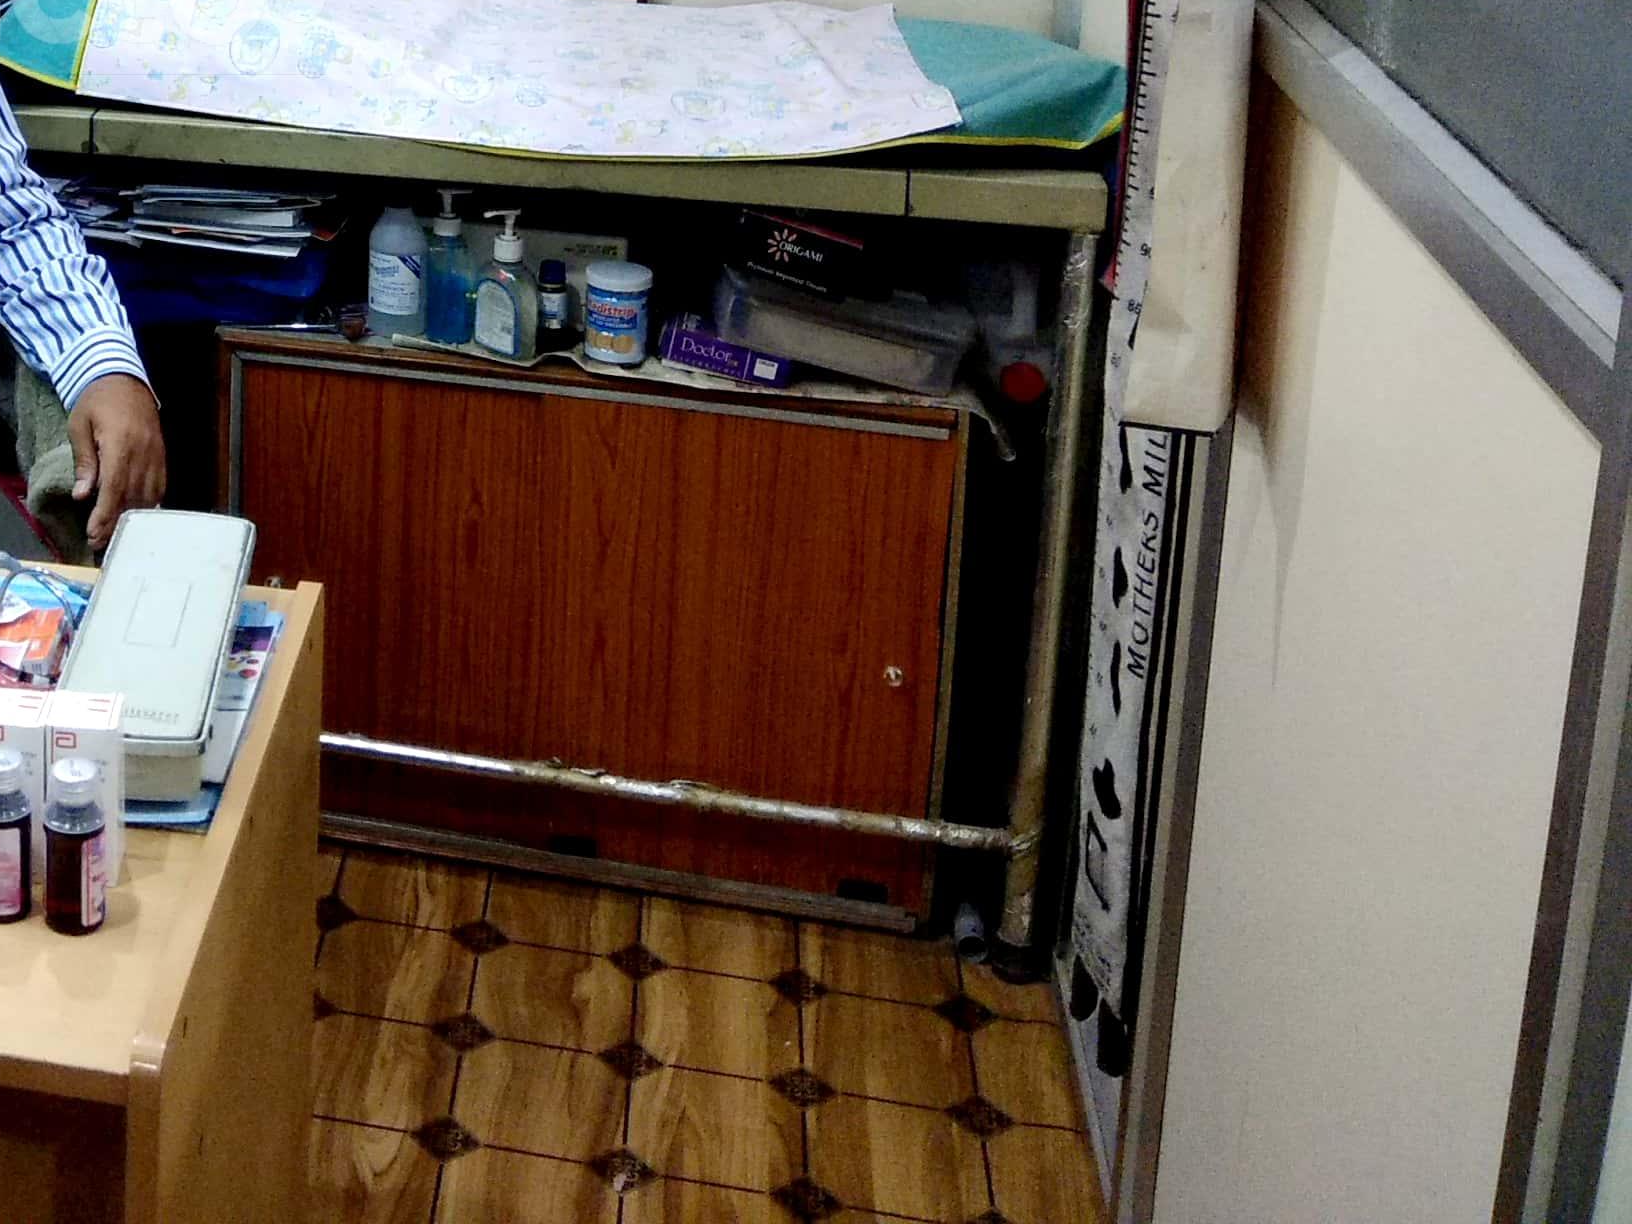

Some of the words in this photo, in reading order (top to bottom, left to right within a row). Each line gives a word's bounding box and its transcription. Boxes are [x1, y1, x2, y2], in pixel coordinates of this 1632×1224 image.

[779, 241, 824, 263] ORIGAMI
[680, 336, 732, 363] Doctor
[1127, 510, 1159, 680] MOTHERS
